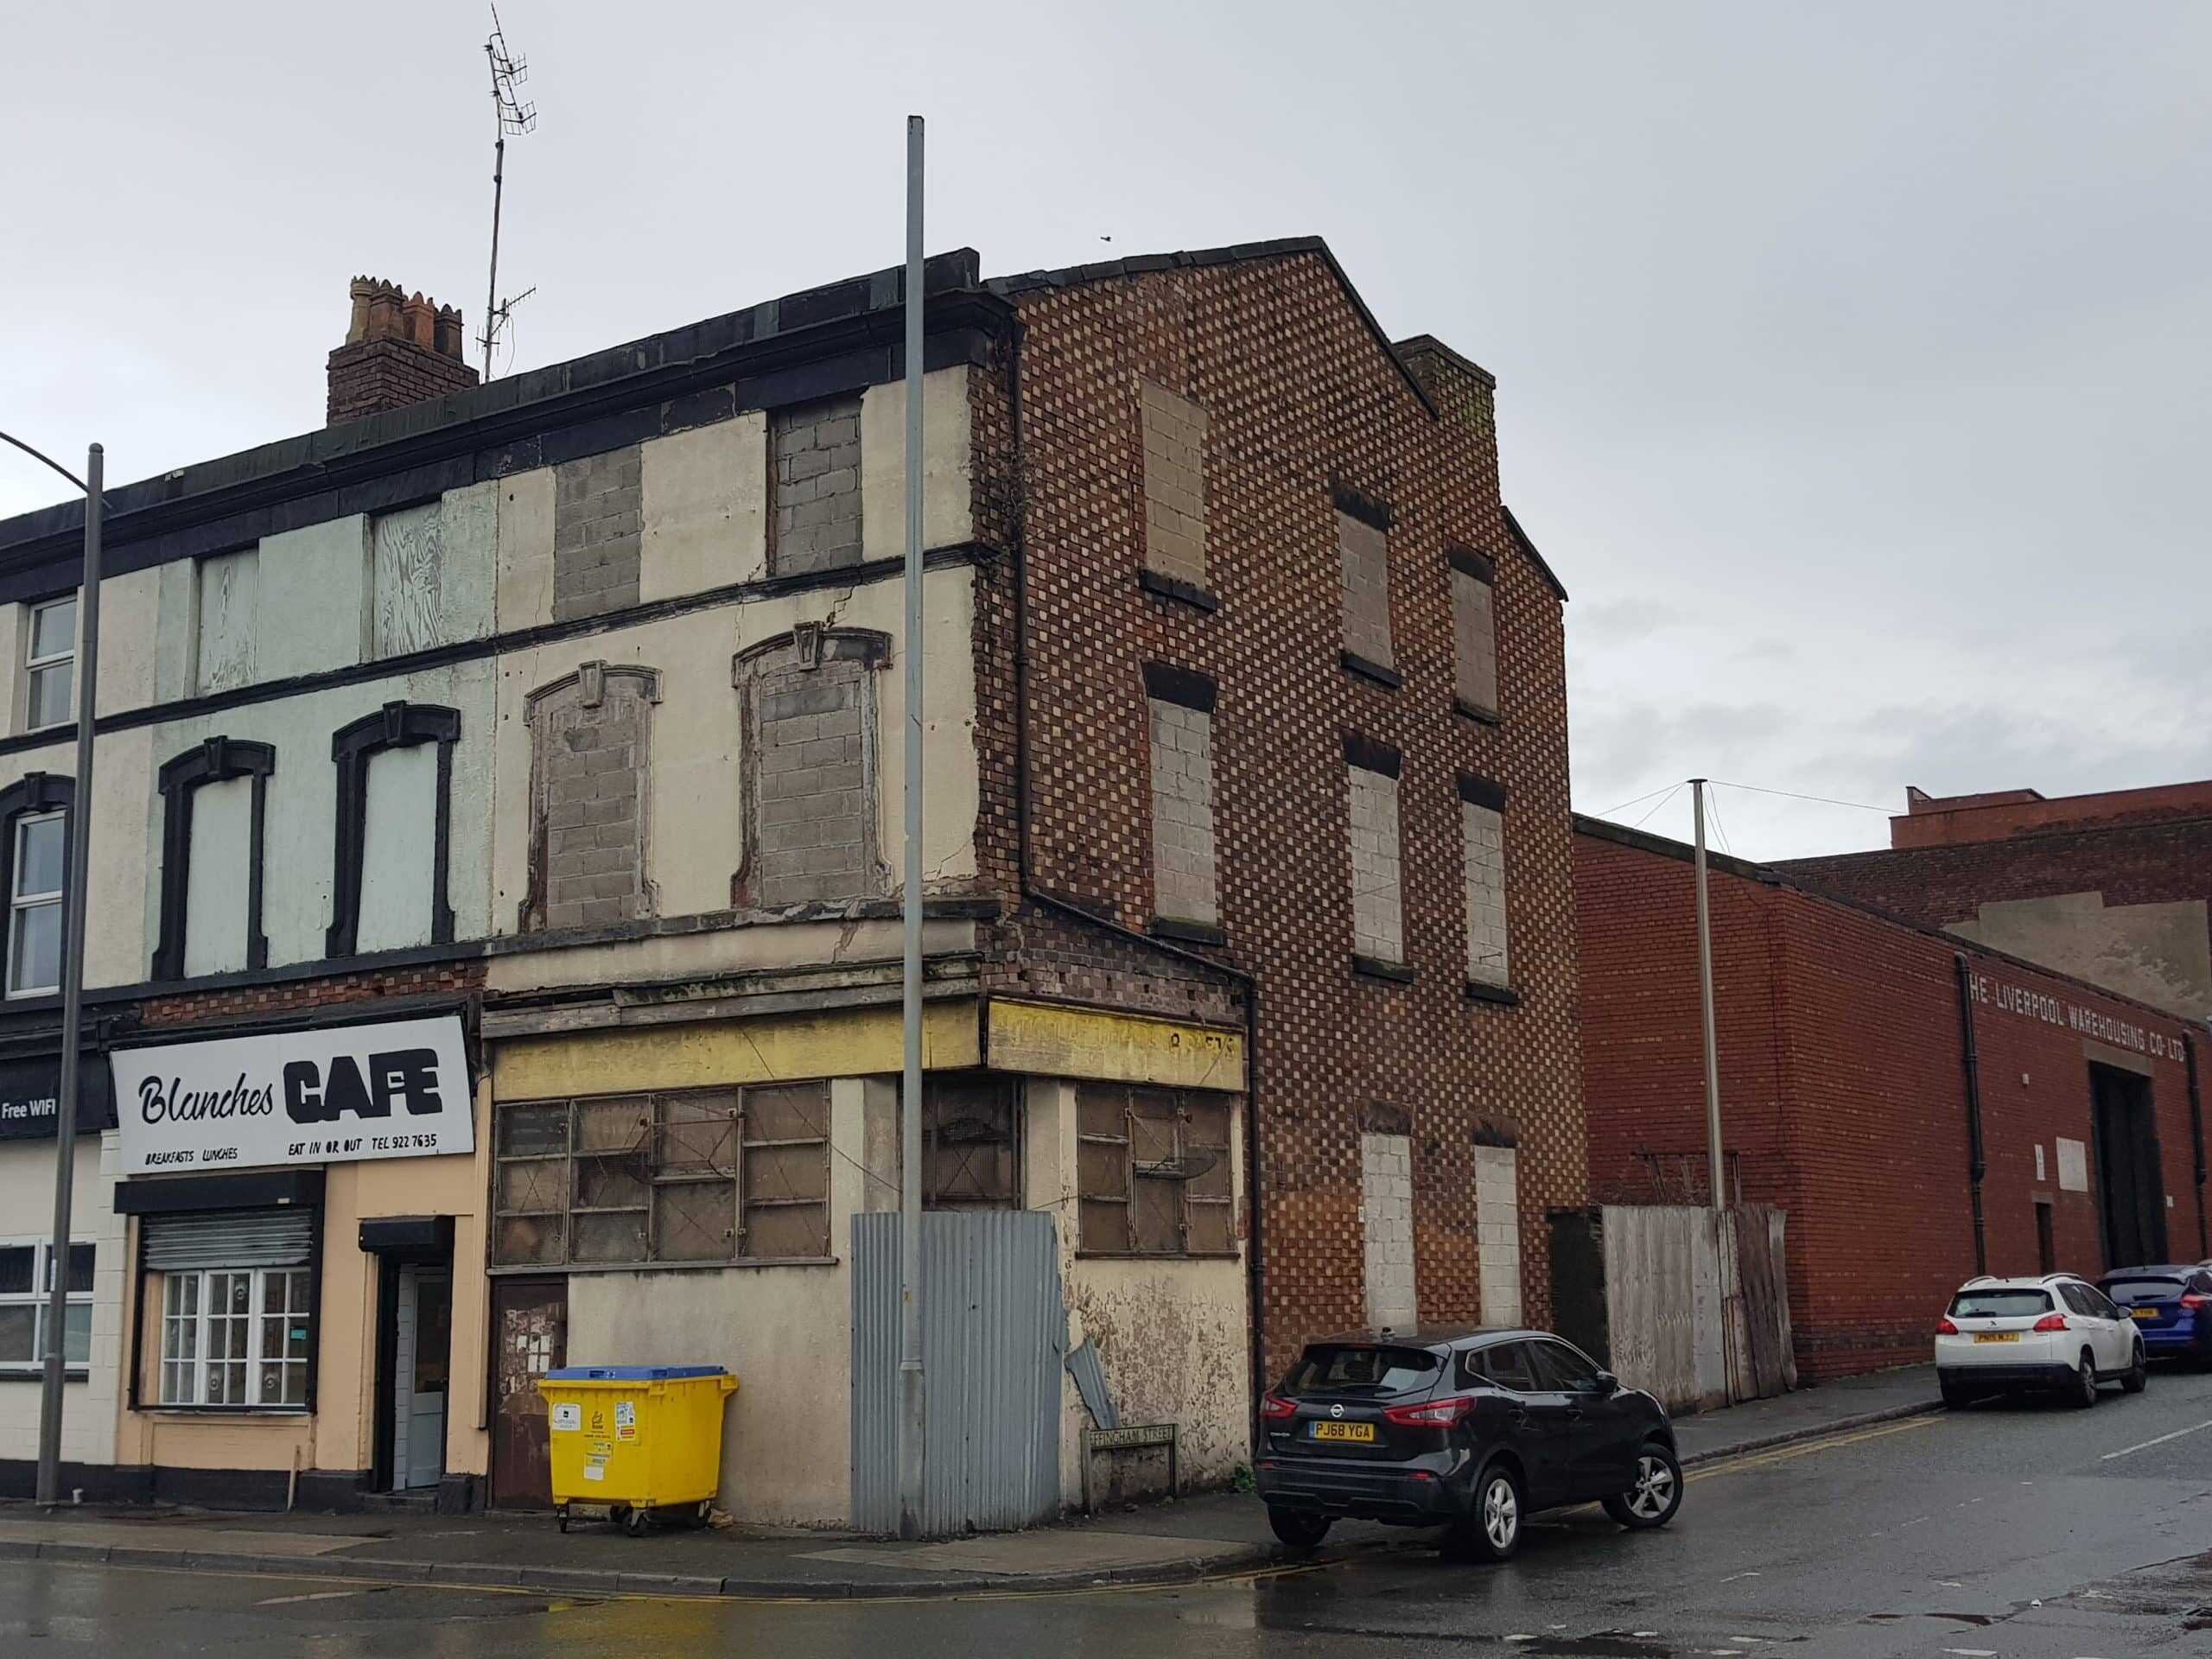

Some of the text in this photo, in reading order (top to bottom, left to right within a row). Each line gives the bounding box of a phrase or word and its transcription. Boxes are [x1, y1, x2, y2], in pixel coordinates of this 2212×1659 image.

[1995, 982, 2064, 1026] LIVERPOOL
[2068, 1004, 2145, 1052] WAREHOUSING
[138, 1048, 443, 1124] Blanches CAFE
[2, 1098, 56, 1119] Free WIFI
[288, 1134, 437, 1156] EAT IN OR OUT TEL 922 7635
[145, 1147, 238, 1166] BREAKFASTS LUNCHES
[1090, 1427, 1172, 1446] EFFINGHAM STREET
[1316, 1422, 1370, 1438] PJ68 YGA
